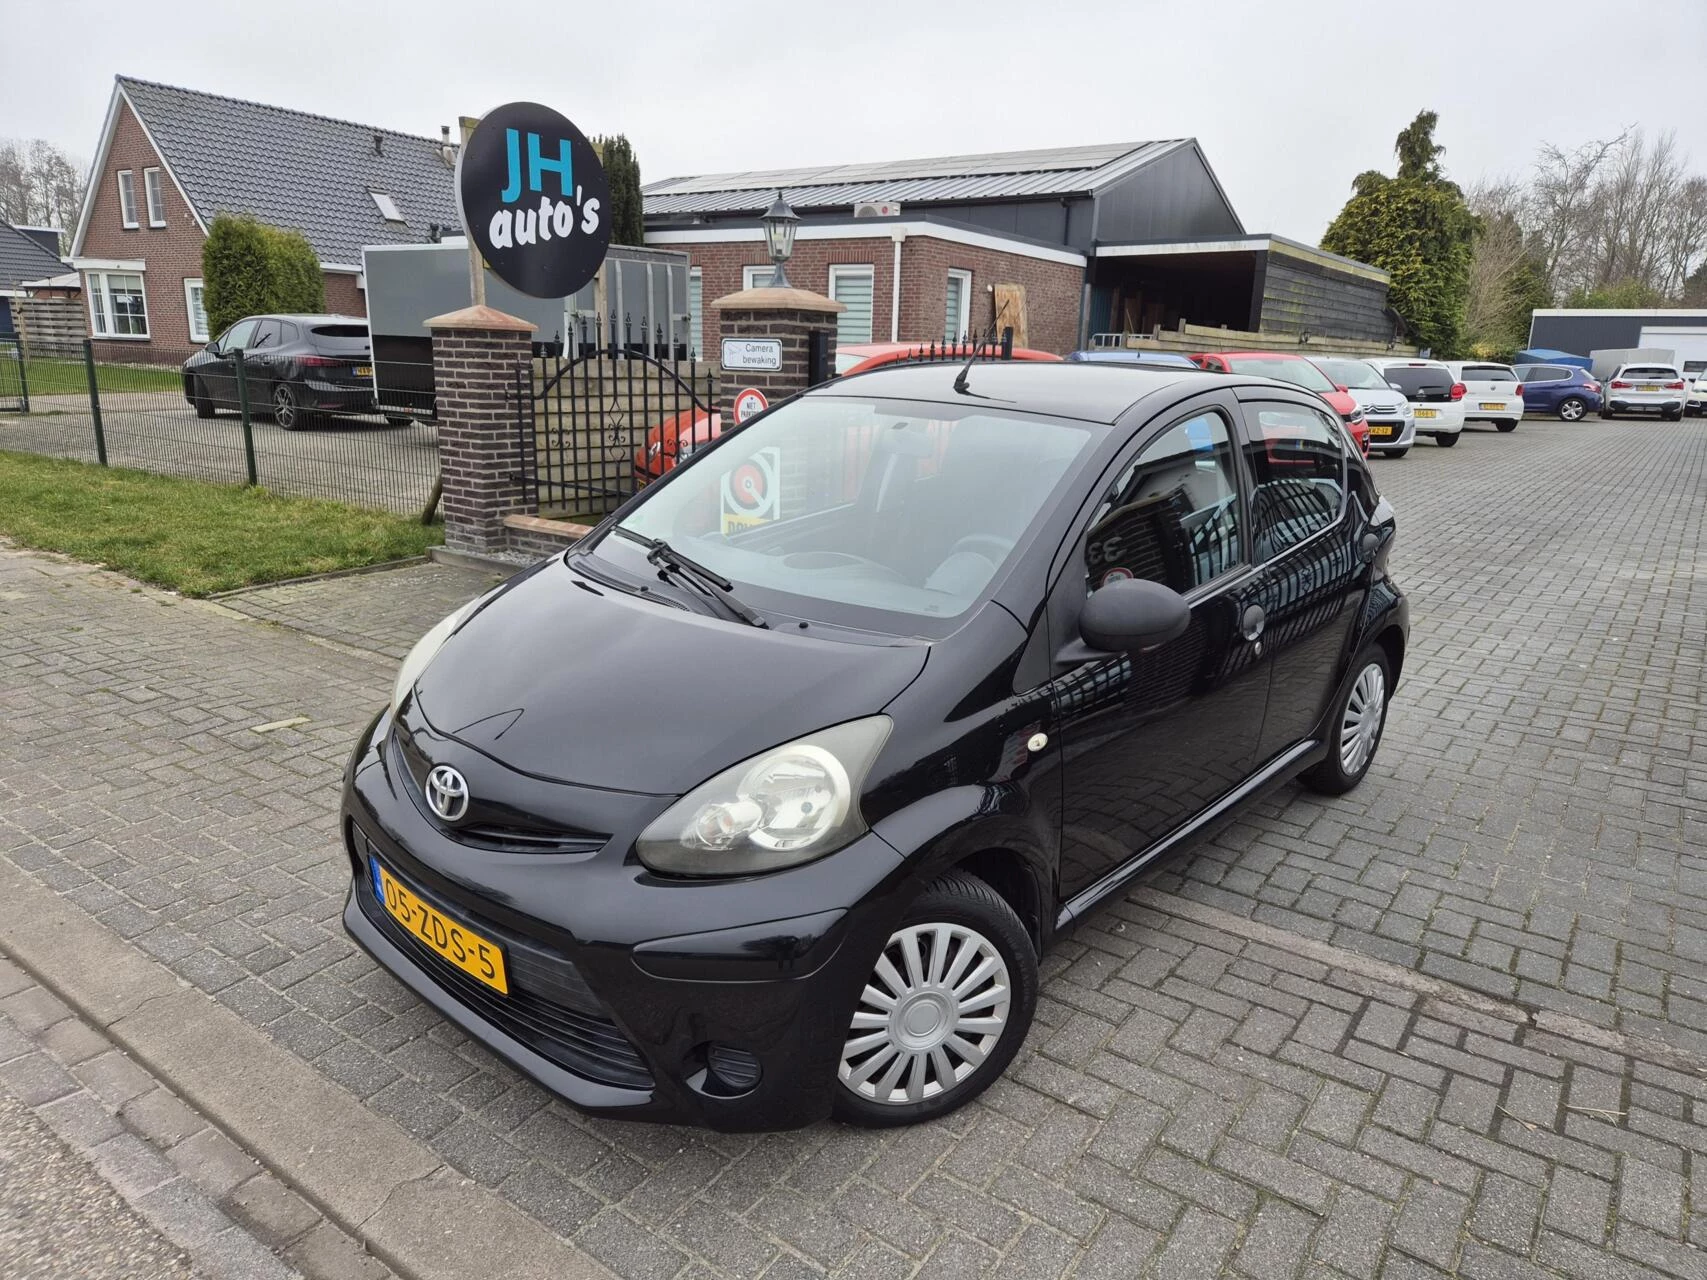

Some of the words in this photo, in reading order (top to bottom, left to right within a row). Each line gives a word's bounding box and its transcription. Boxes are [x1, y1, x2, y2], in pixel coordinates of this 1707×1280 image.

[502, 128, 573, 204] JH
[489, 185, 600, 249] auto's
[742, 356, 777, 367] bewaking
[745, 343, 773, 353] Camera
[385, 878, 495, 979] 05-ZDS-5
